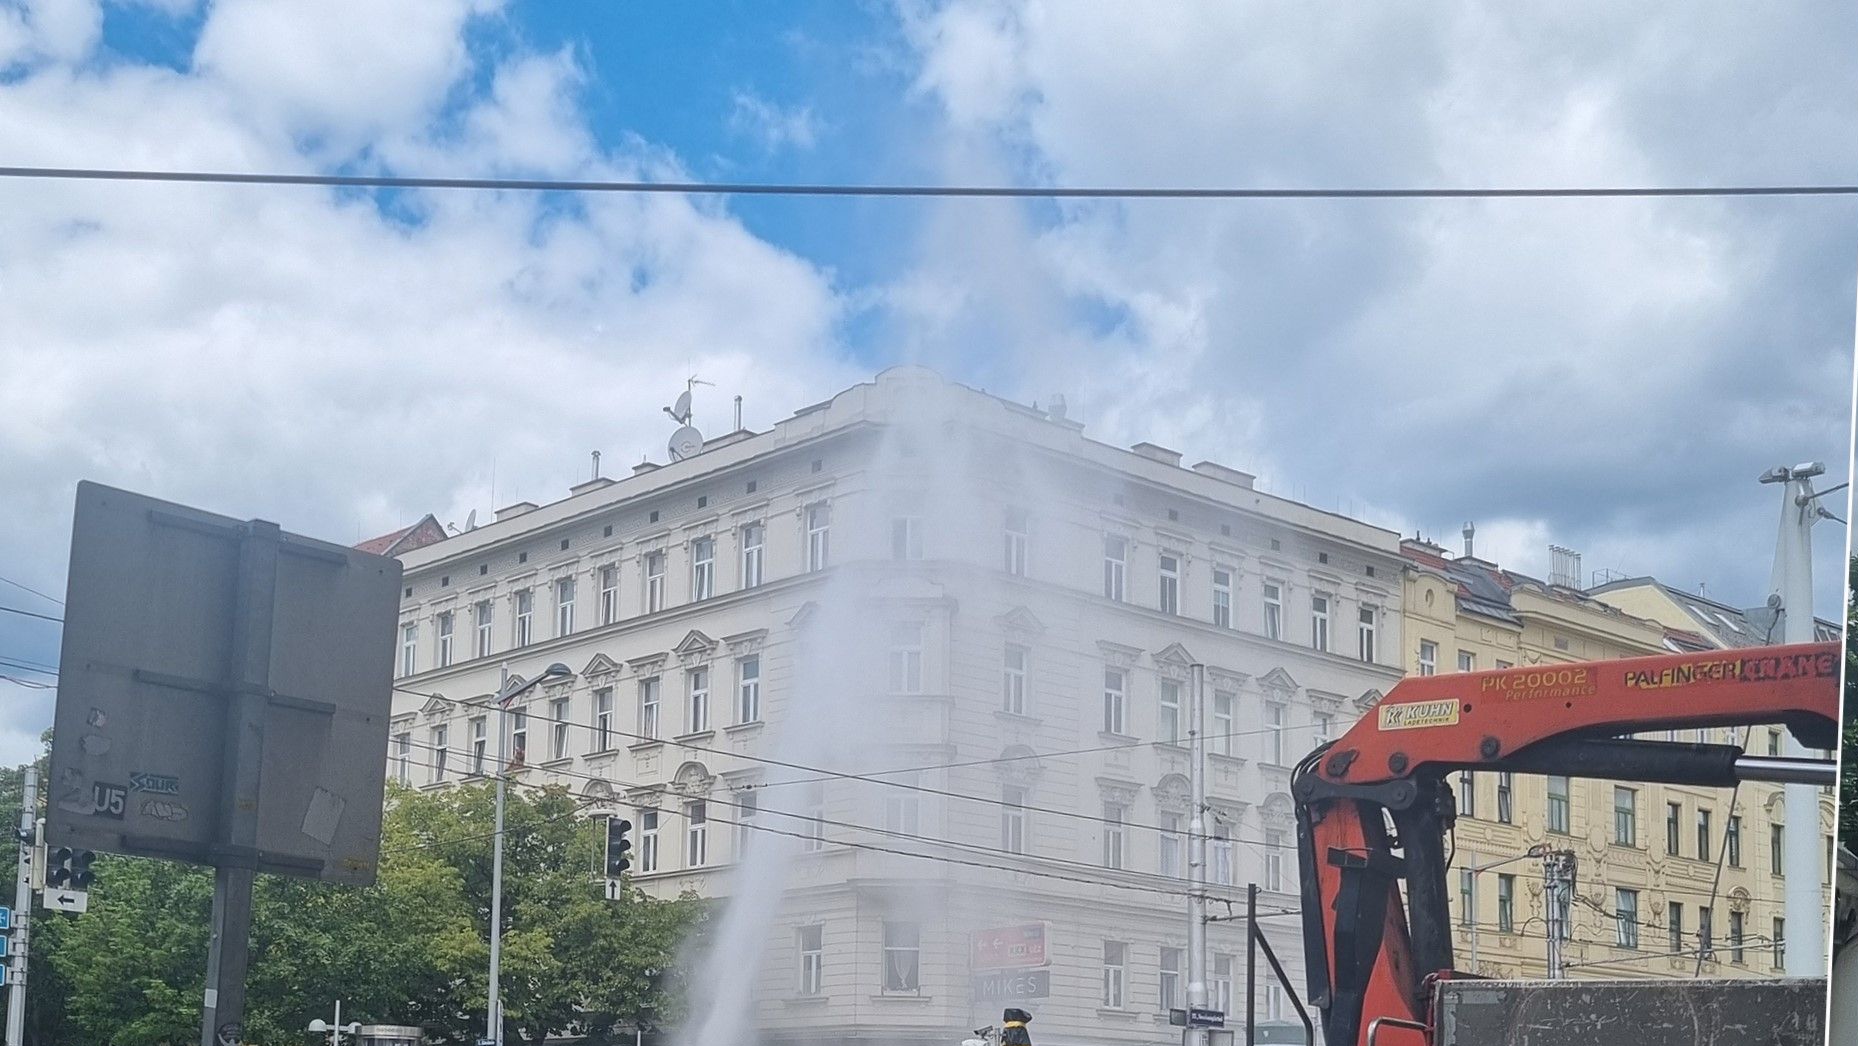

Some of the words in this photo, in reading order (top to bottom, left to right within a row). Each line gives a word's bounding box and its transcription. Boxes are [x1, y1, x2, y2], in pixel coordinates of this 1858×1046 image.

[1482, 676, 1507, 692] PK
[1513, 668, 1588, 690] 20002
[1624, 661, 1736, 687] PALFINGER
[1506, 684, 1597, 701] Performance
[1406, 702, 1454, 719] KUHN
[94, 785, 126, 815] U5
